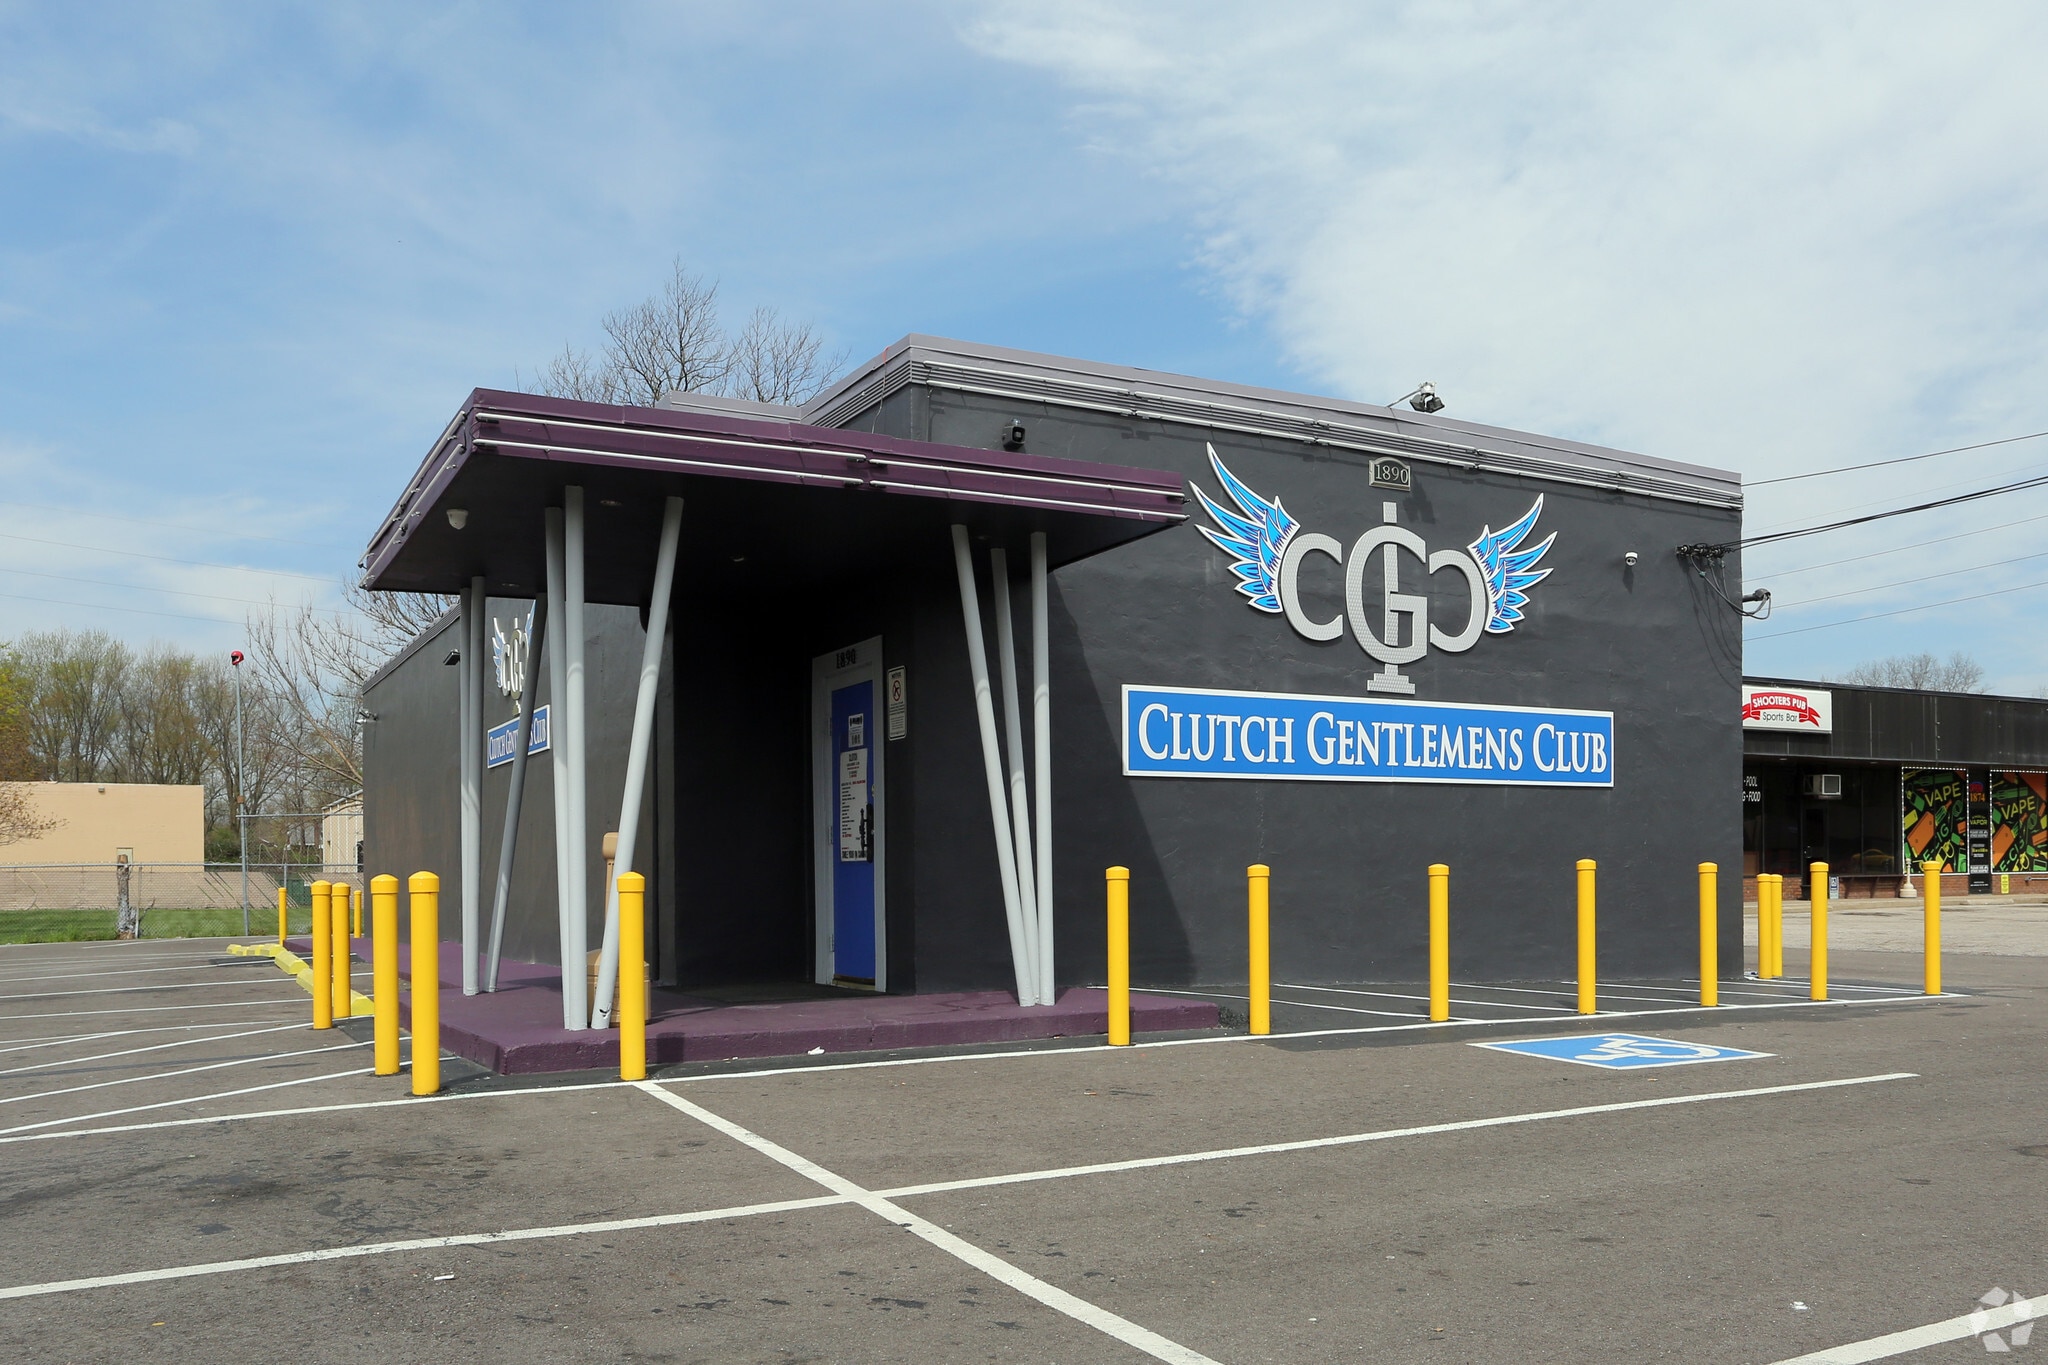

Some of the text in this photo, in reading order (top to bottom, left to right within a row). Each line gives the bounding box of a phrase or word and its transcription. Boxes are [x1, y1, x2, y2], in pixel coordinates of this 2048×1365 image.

[1375, 464, 1409, 484] 1890
[836, 648, 857, 669] 1890
[1753, 696, 1806, 710] SHOOTERS PUB
[1762, 712, 1798, 722] Sports Bar
[1138, 703, 1608, 774] CLUTCH GENTLEMENS CLUB
[1924, 783, 1961, 807] VAPE
[1970, 793, 1985, 803] 1874
[2001, 796, 2035, 820] VAPE
